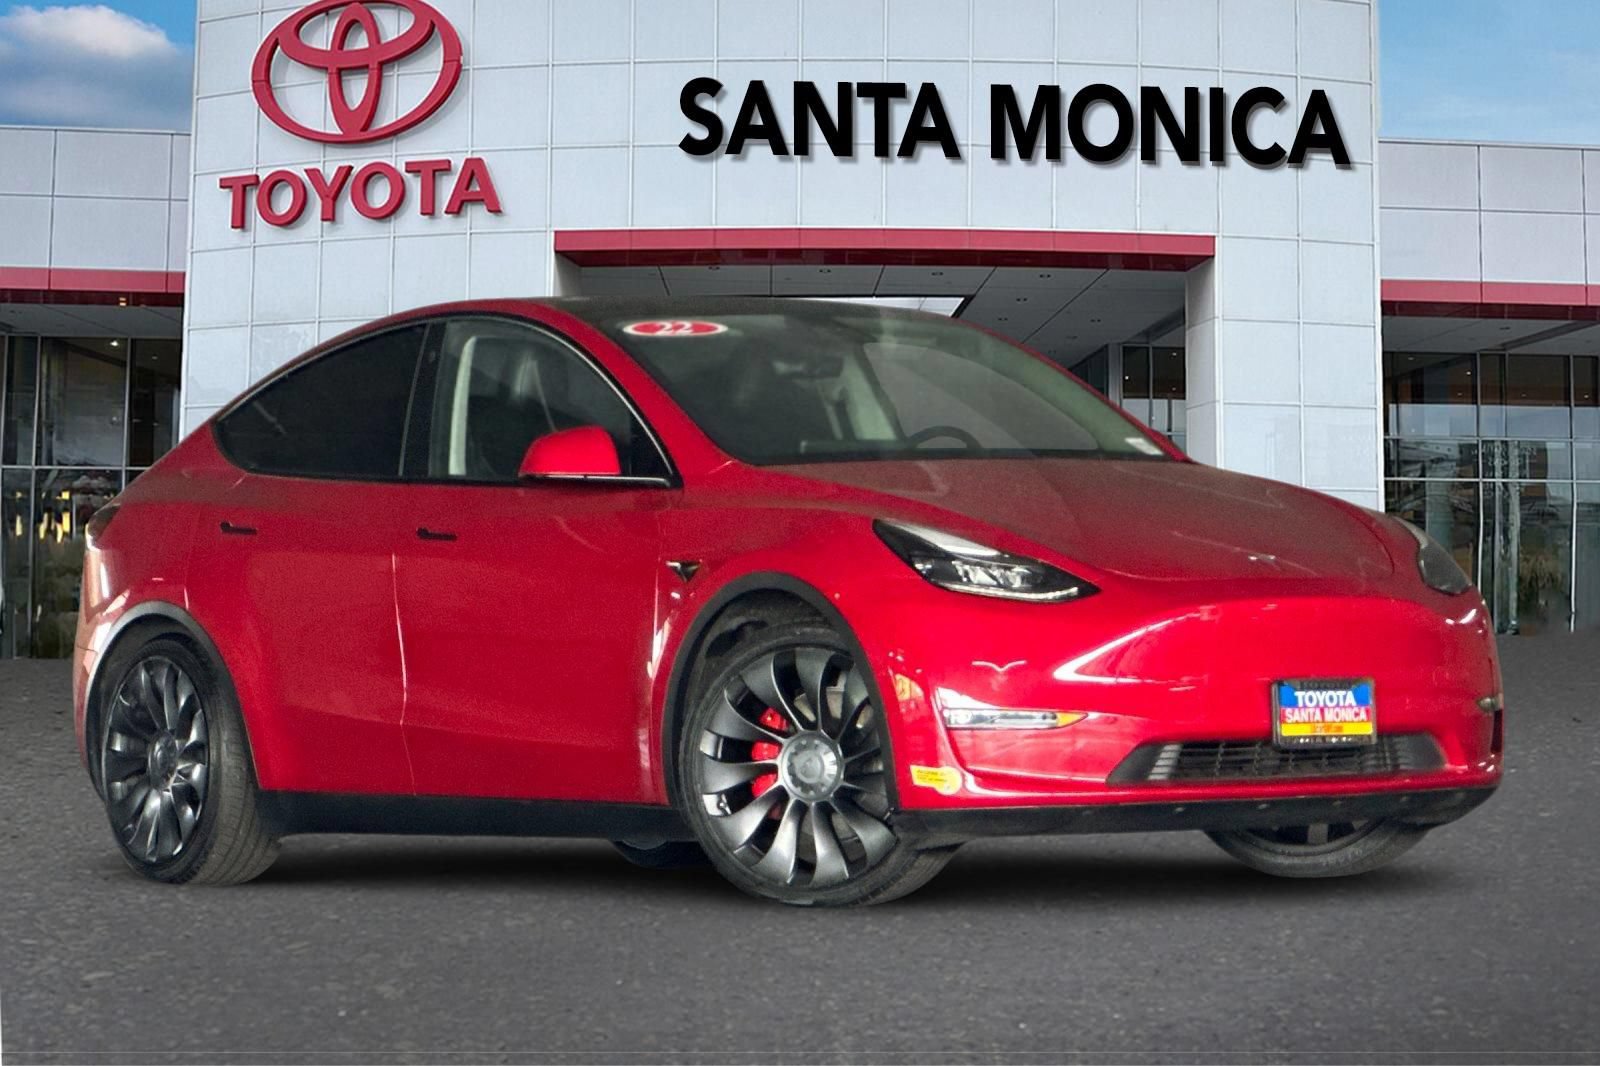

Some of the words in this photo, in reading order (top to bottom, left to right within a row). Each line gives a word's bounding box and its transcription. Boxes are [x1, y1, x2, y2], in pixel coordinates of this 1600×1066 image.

[678, 76, 962, 160] SANTA
[990, 82, 1351, 168] MONICA
[219, 156, 502, 230] TOYOTA
[655, 320, 694, 337] 22
[1294, 690, 1357, 707] TOYOTA
[1285, 707, 1322, 722] SANTA
[1324, 706, 1368, 722] MONICA
